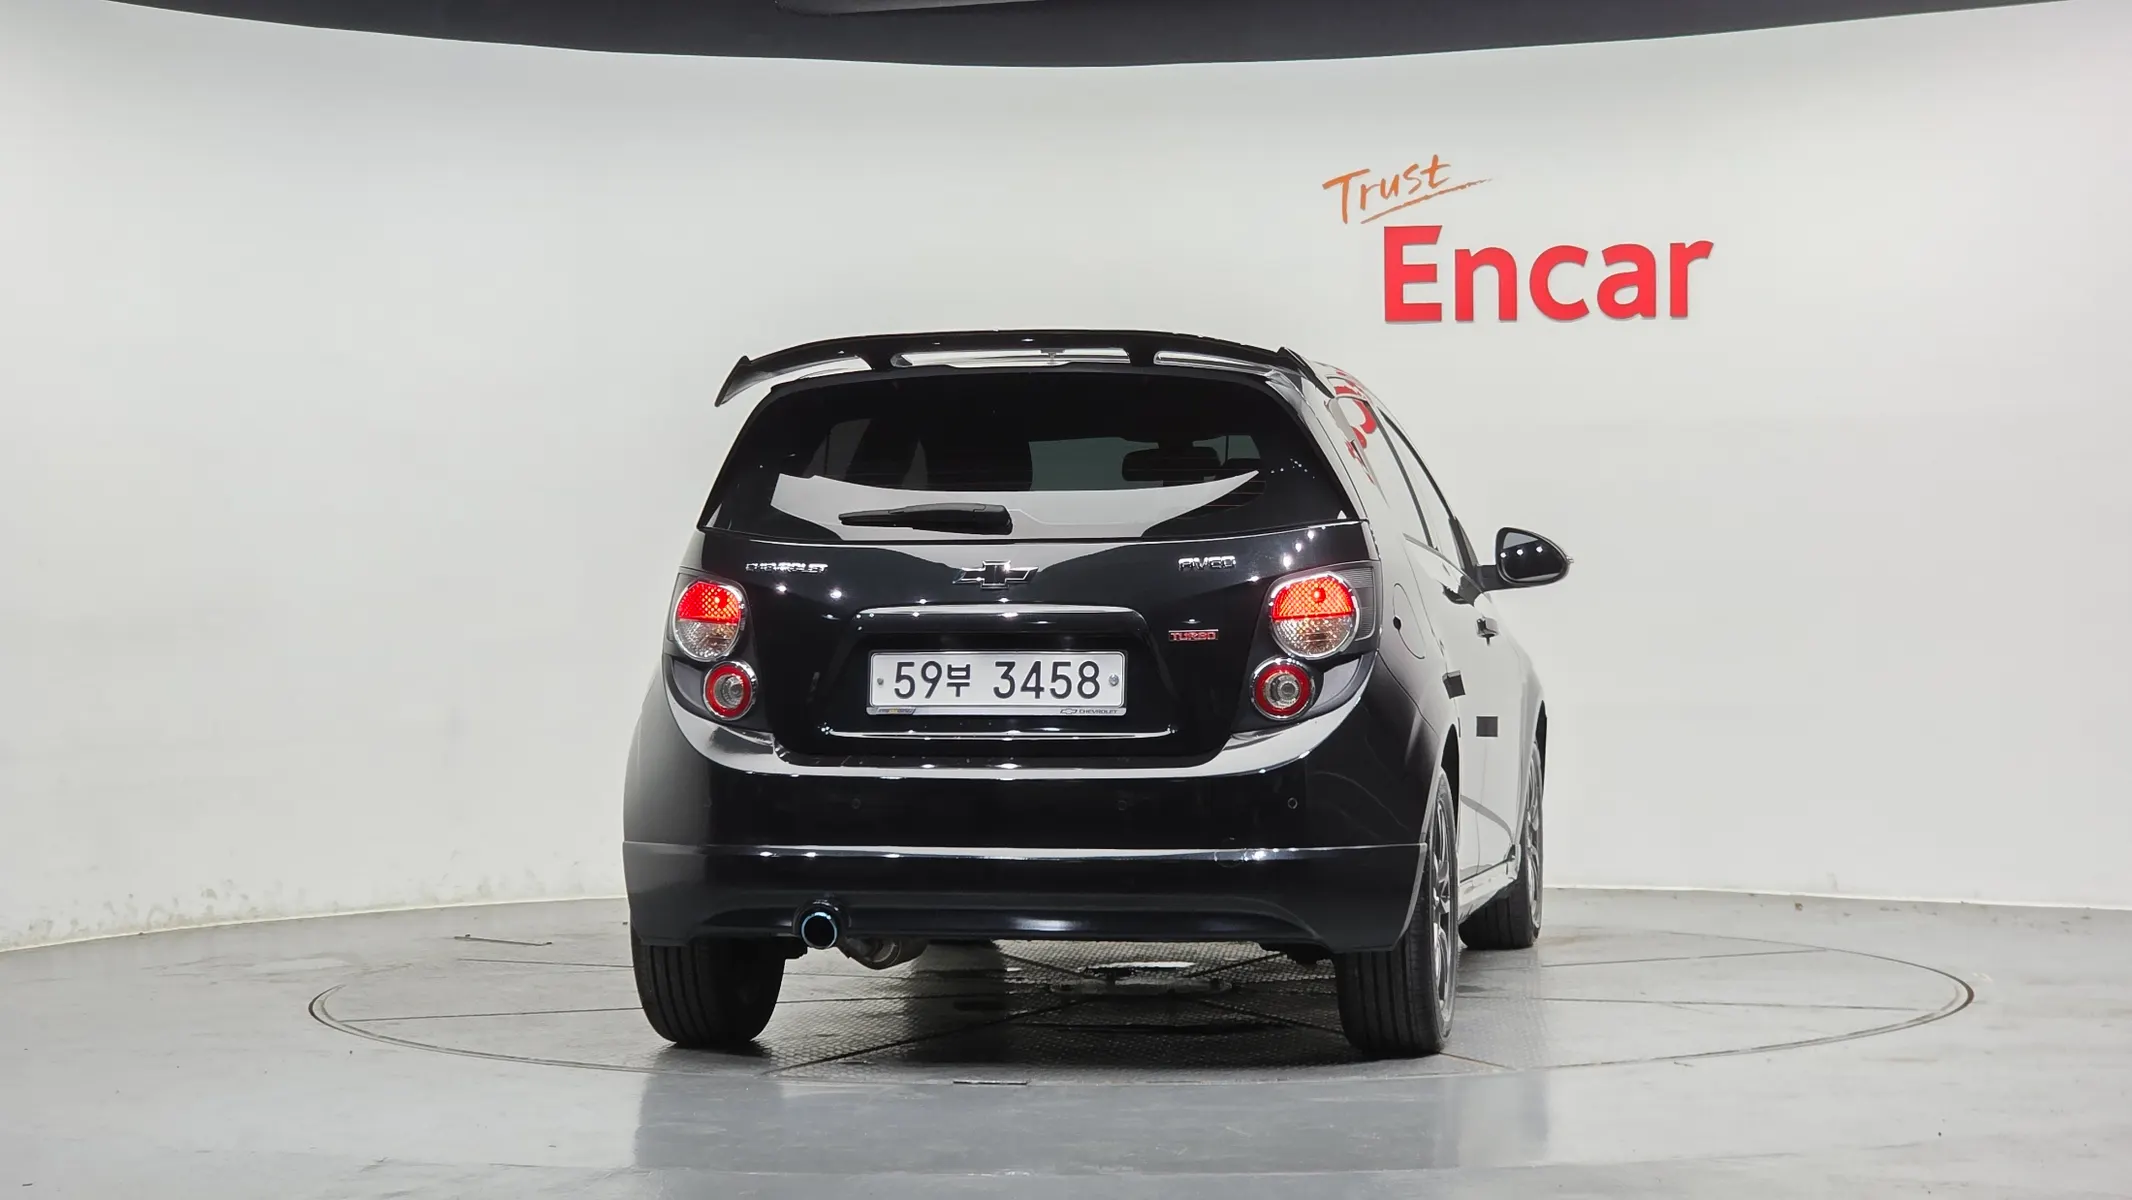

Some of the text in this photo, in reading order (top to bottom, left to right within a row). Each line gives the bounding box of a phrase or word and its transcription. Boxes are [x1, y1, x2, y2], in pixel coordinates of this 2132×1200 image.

[1322, 154, 1451, 225] Trust
[1384, 225, 1714, 322] Encar
[745, 562, 828, 573] CHEVROLET
[1169, 632, 1217, 641] TURBO
[894, 660, 1101, 699] 59부 3458
